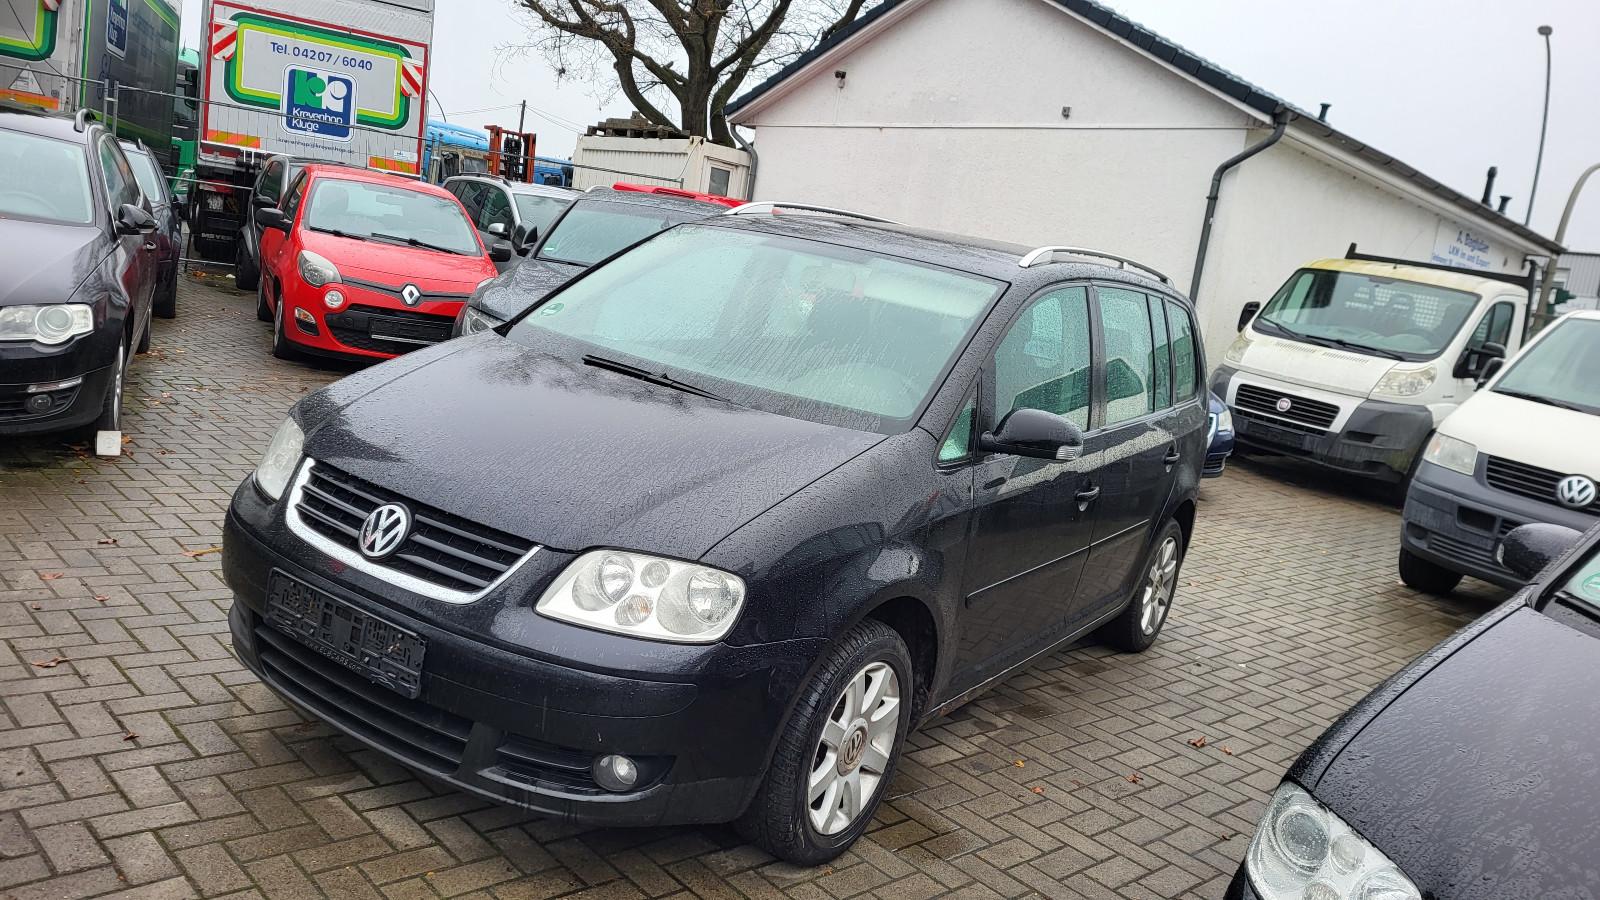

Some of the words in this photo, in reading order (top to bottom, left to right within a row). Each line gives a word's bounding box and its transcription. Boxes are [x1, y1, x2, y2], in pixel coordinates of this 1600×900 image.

[270, 42, 290, 55] Tel.
[292, 46, 333, 63] 04207
[342, 56, 373, 71] 6040
[292, 118, 319, 132] Kluge
